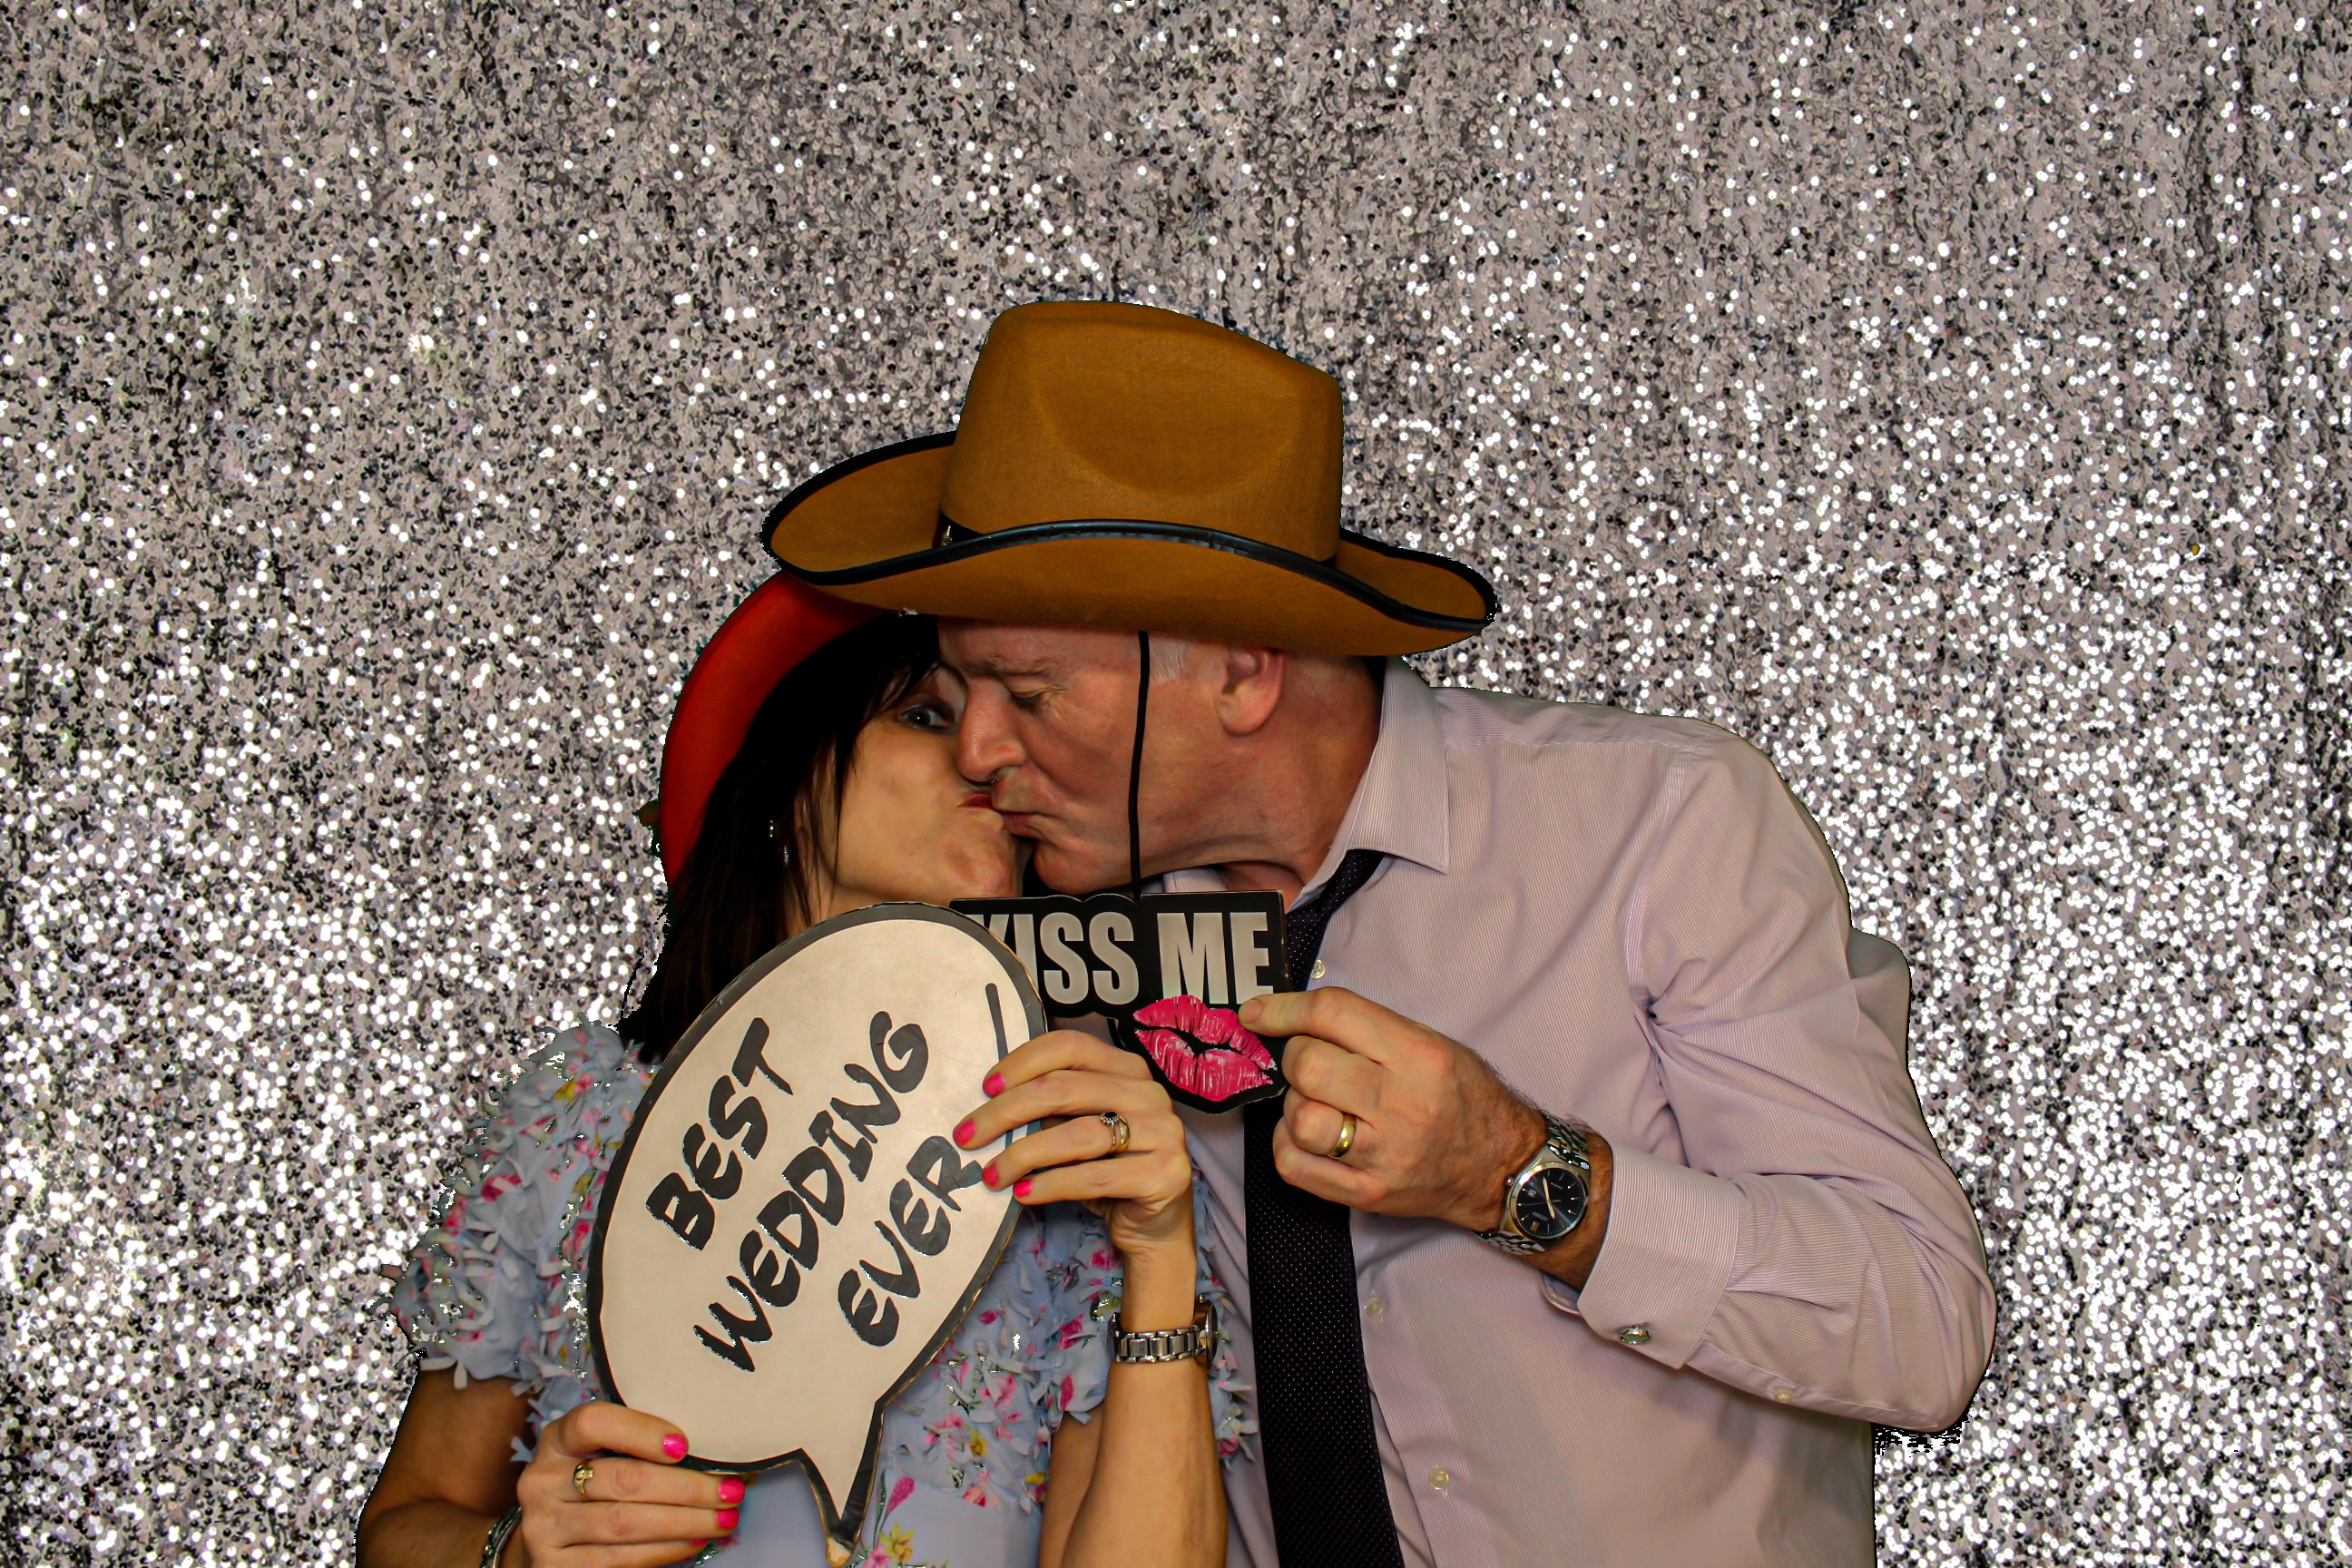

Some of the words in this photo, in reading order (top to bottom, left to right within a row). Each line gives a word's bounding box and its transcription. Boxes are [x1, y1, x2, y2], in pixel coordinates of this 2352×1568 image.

[1157, 911, 1274, 1004] ME
[646, 1017, 794, 1251] BEST
[693, 1011, 929, 1373] WEDDING
